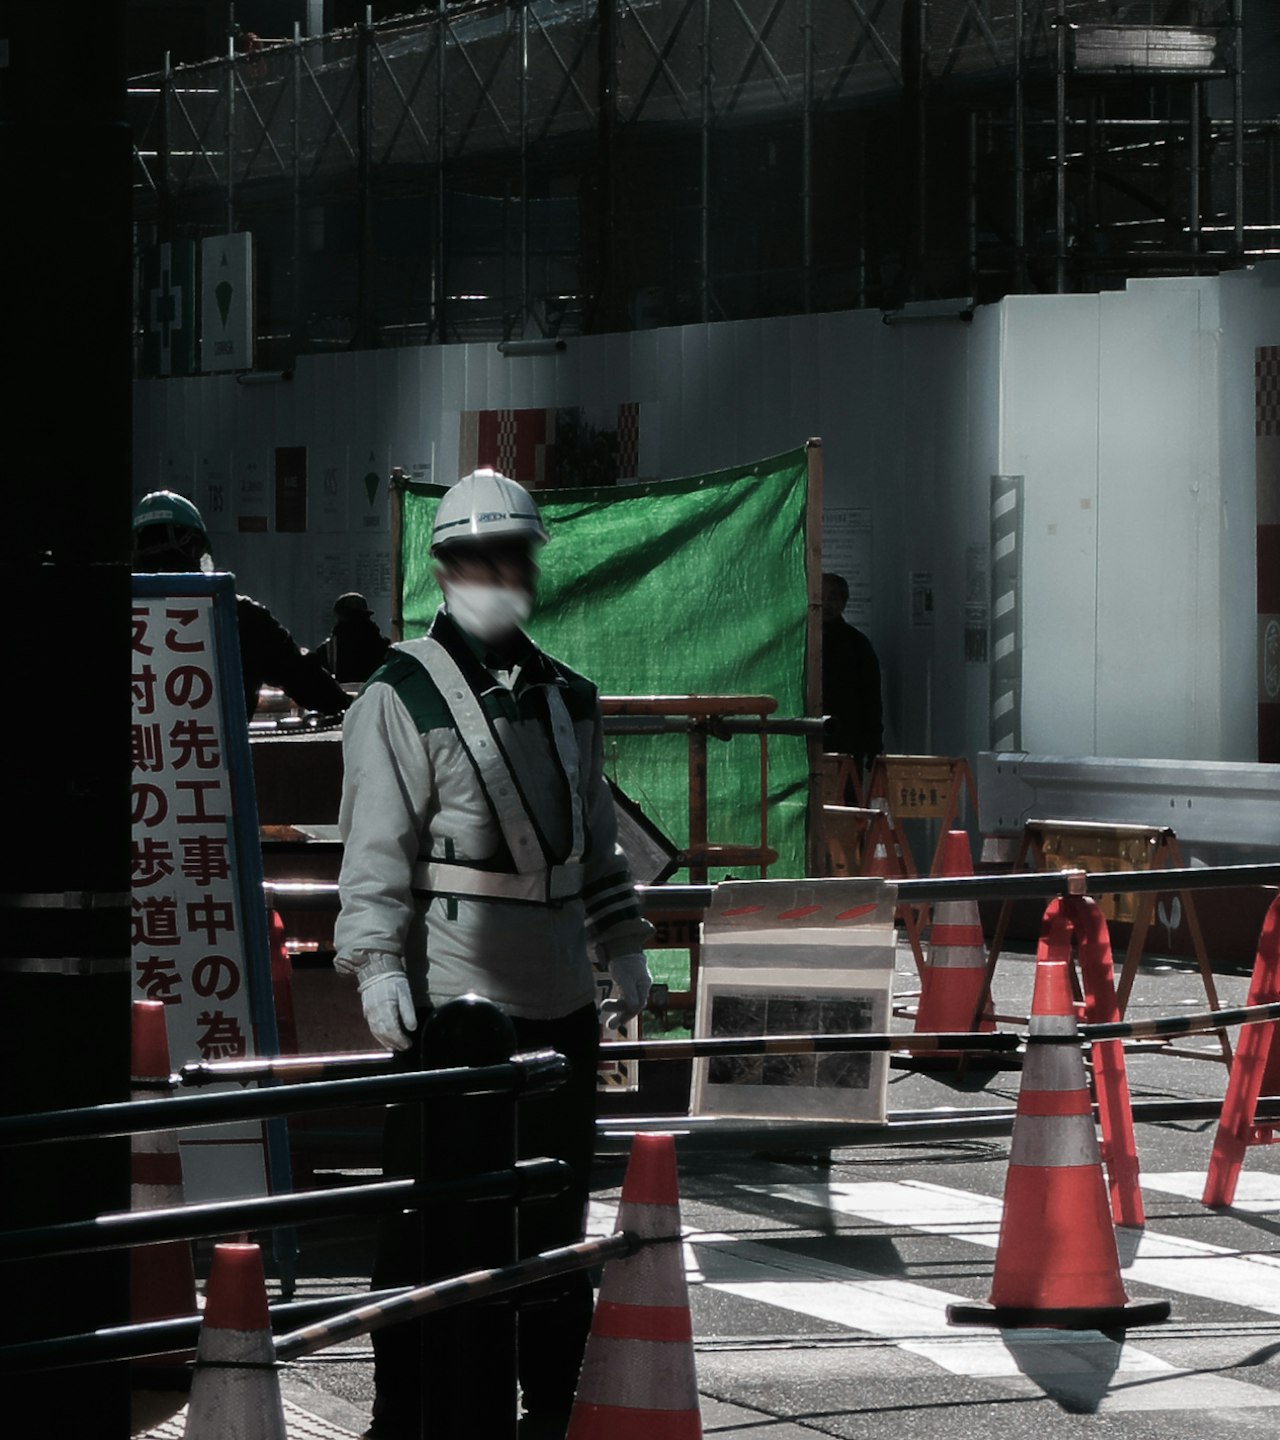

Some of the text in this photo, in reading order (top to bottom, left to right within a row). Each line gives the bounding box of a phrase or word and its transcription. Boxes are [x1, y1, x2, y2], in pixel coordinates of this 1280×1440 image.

[165, 609, 247, 1061] この先工事中の為
